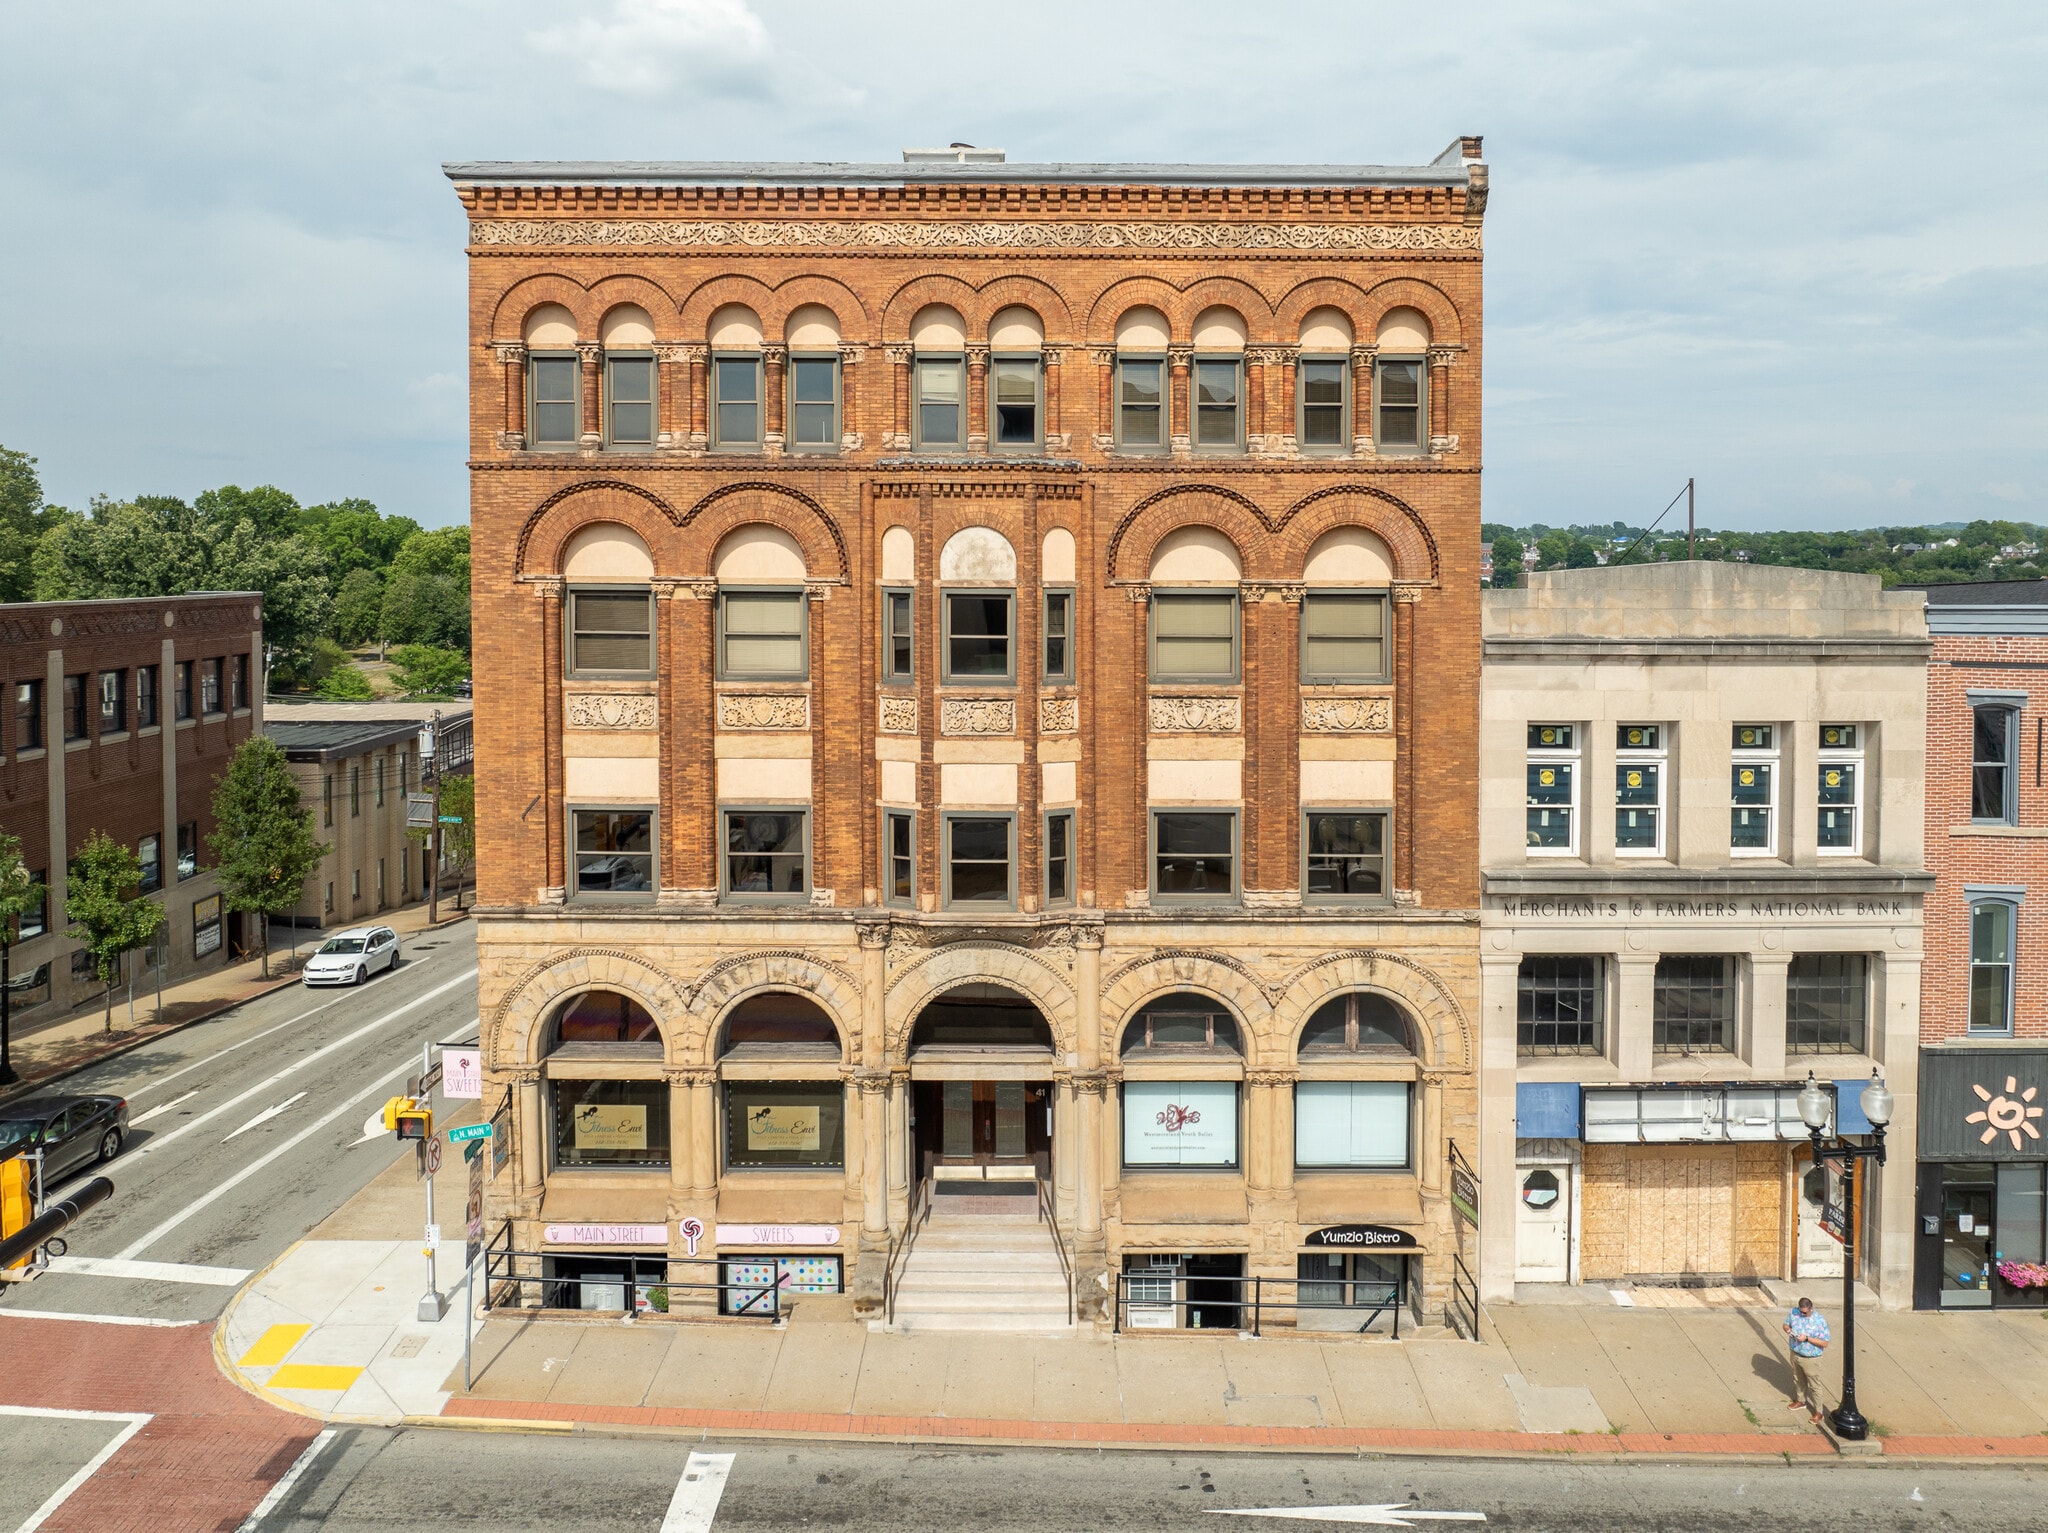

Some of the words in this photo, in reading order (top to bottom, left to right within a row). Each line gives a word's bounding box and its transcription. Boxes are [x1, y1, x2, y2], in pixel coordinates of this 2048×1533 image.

[1504, 903, 1618, 917] MERCHANTS
[1632, 903, 1642, 917] &
[1656, 902, 1737, 917] FARMERS
[1751, 902, 1845, 916] NATIONAL
[1857, 902, 1902, 916] BANK
[1035, 1089, 1046, 1097] 41
[459, 1130, 467, 1138] N.
[467, 1127, 485, 1137] MAIN
[573, 1227, 605, 1241] MAIN
[609, 1227, 645, 1242] STREET
[752, 1227, 795, 1242] SWEETS
[1320, 1231, 1363, 1244] Yumzio
[1364, 1231, 1400, 1244] Bistro
